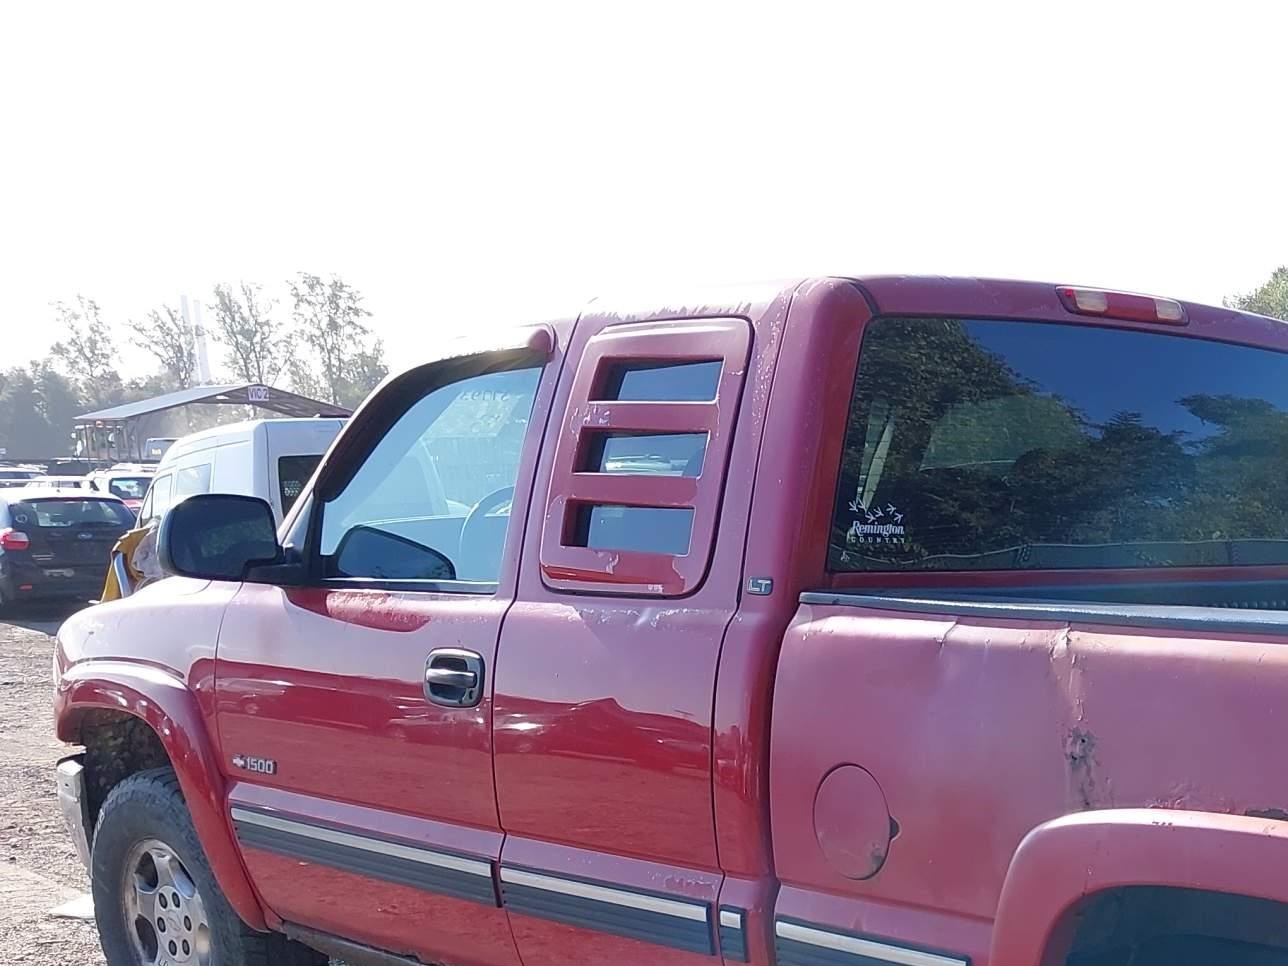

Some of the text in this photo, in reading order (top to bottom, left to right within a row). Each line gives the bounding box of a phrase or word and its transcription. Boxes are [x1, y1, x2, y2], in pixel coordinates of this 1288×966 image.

[852, 520, 905, 537] Remington
[850, 536, 905, 544] COUNTRY
[748, 579, 772, 592] LT
[246, 756, 274, 774] 1500
